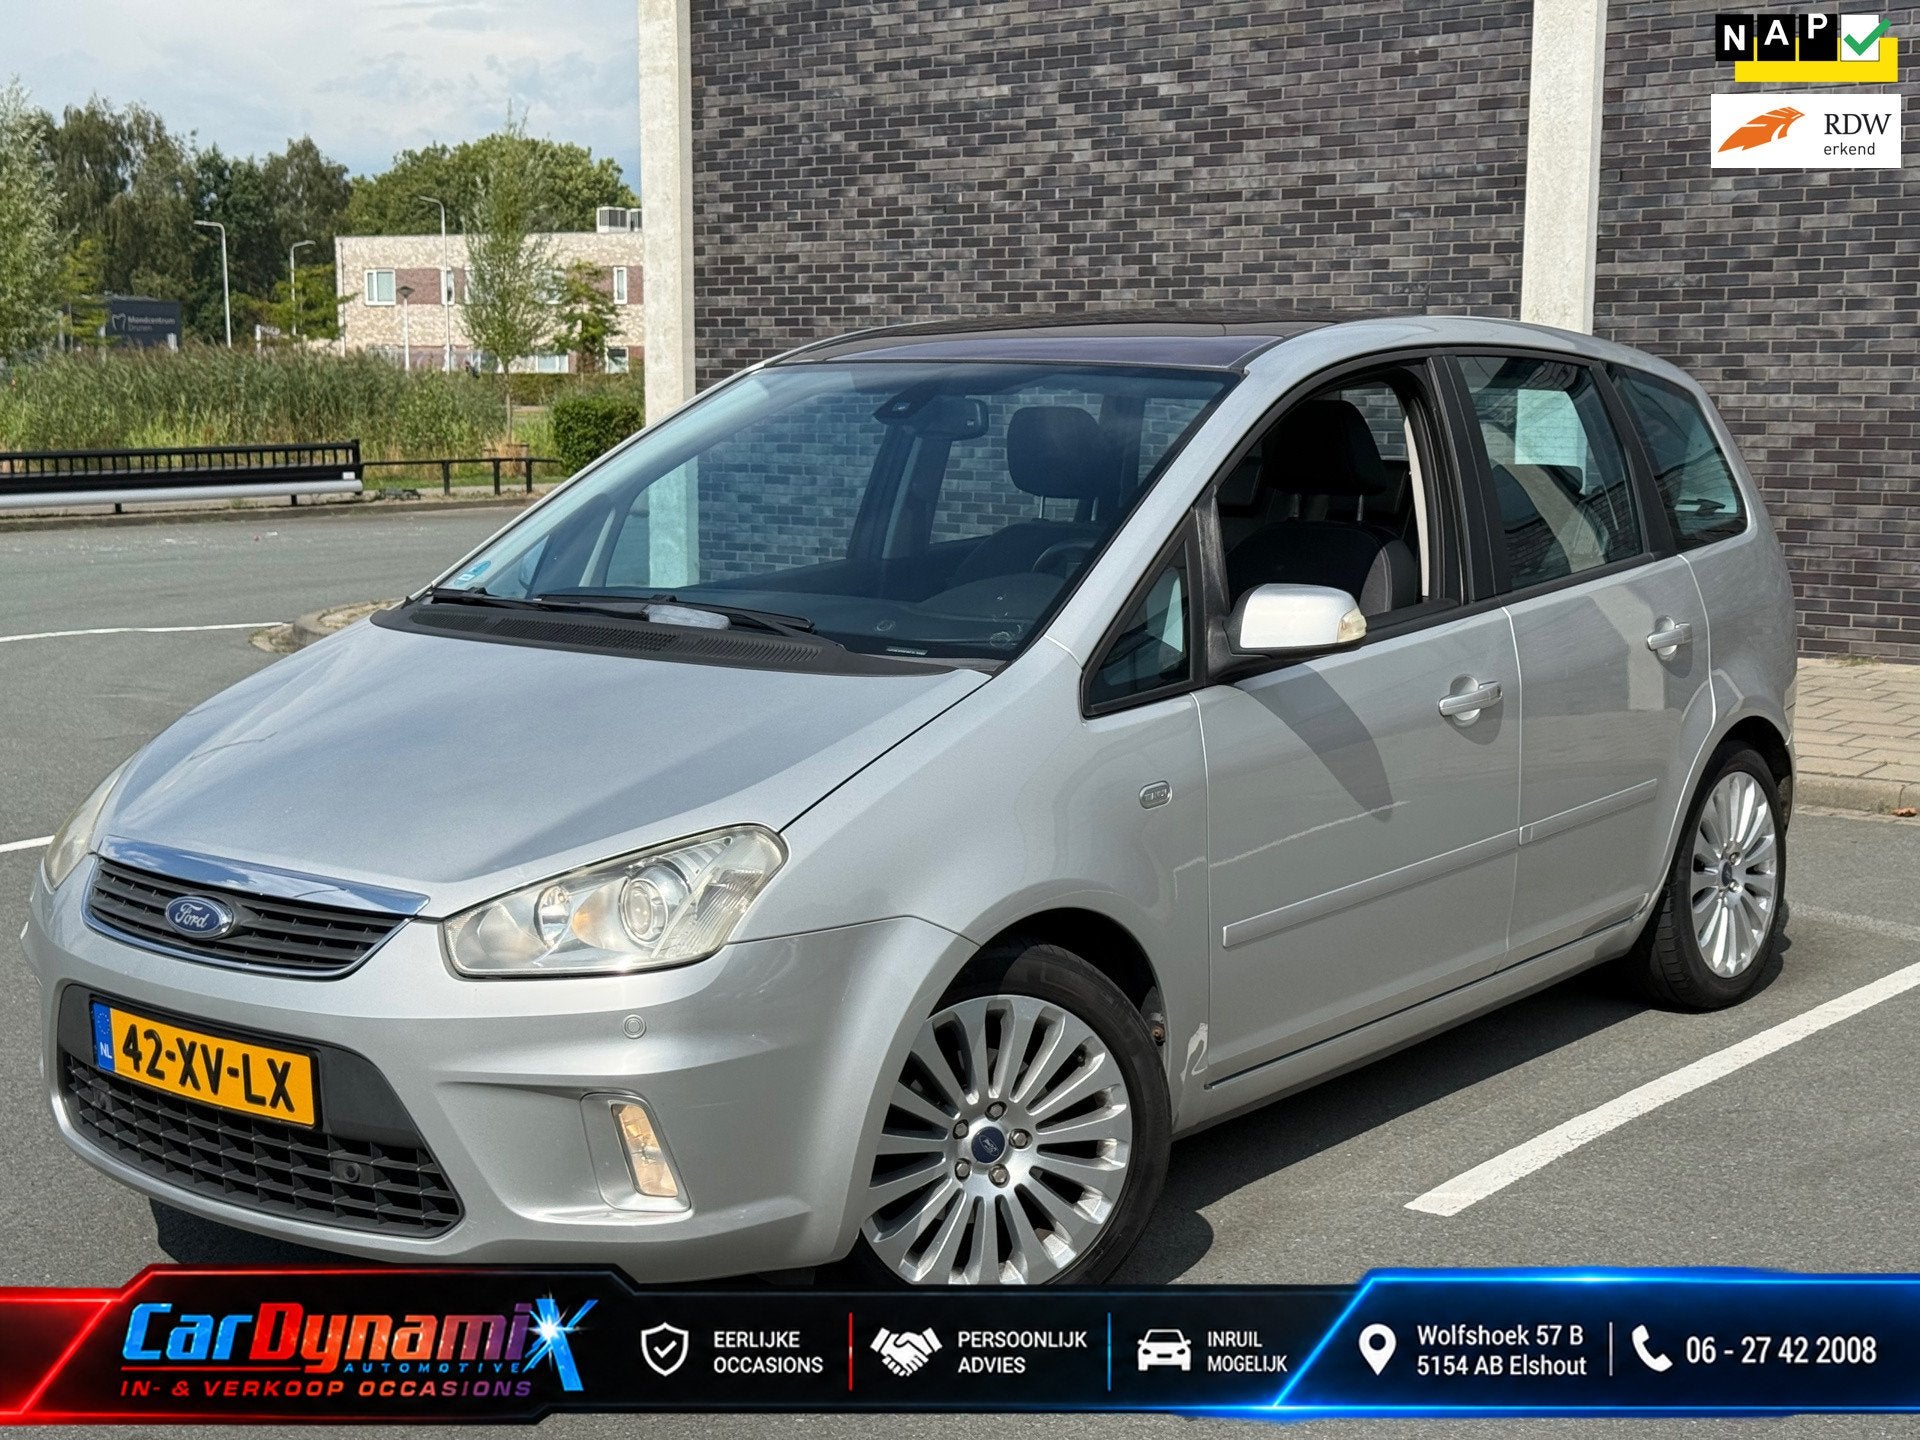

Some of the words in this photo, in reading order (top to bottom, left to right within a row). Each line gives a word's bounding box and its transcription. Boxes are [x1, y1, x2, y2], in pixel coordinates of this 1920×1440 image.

[174, 902, 210, 929] Ford
[100, 1042, 113, 1060] NL
[122, 1023, 296, 1113] 42-XV-LX
